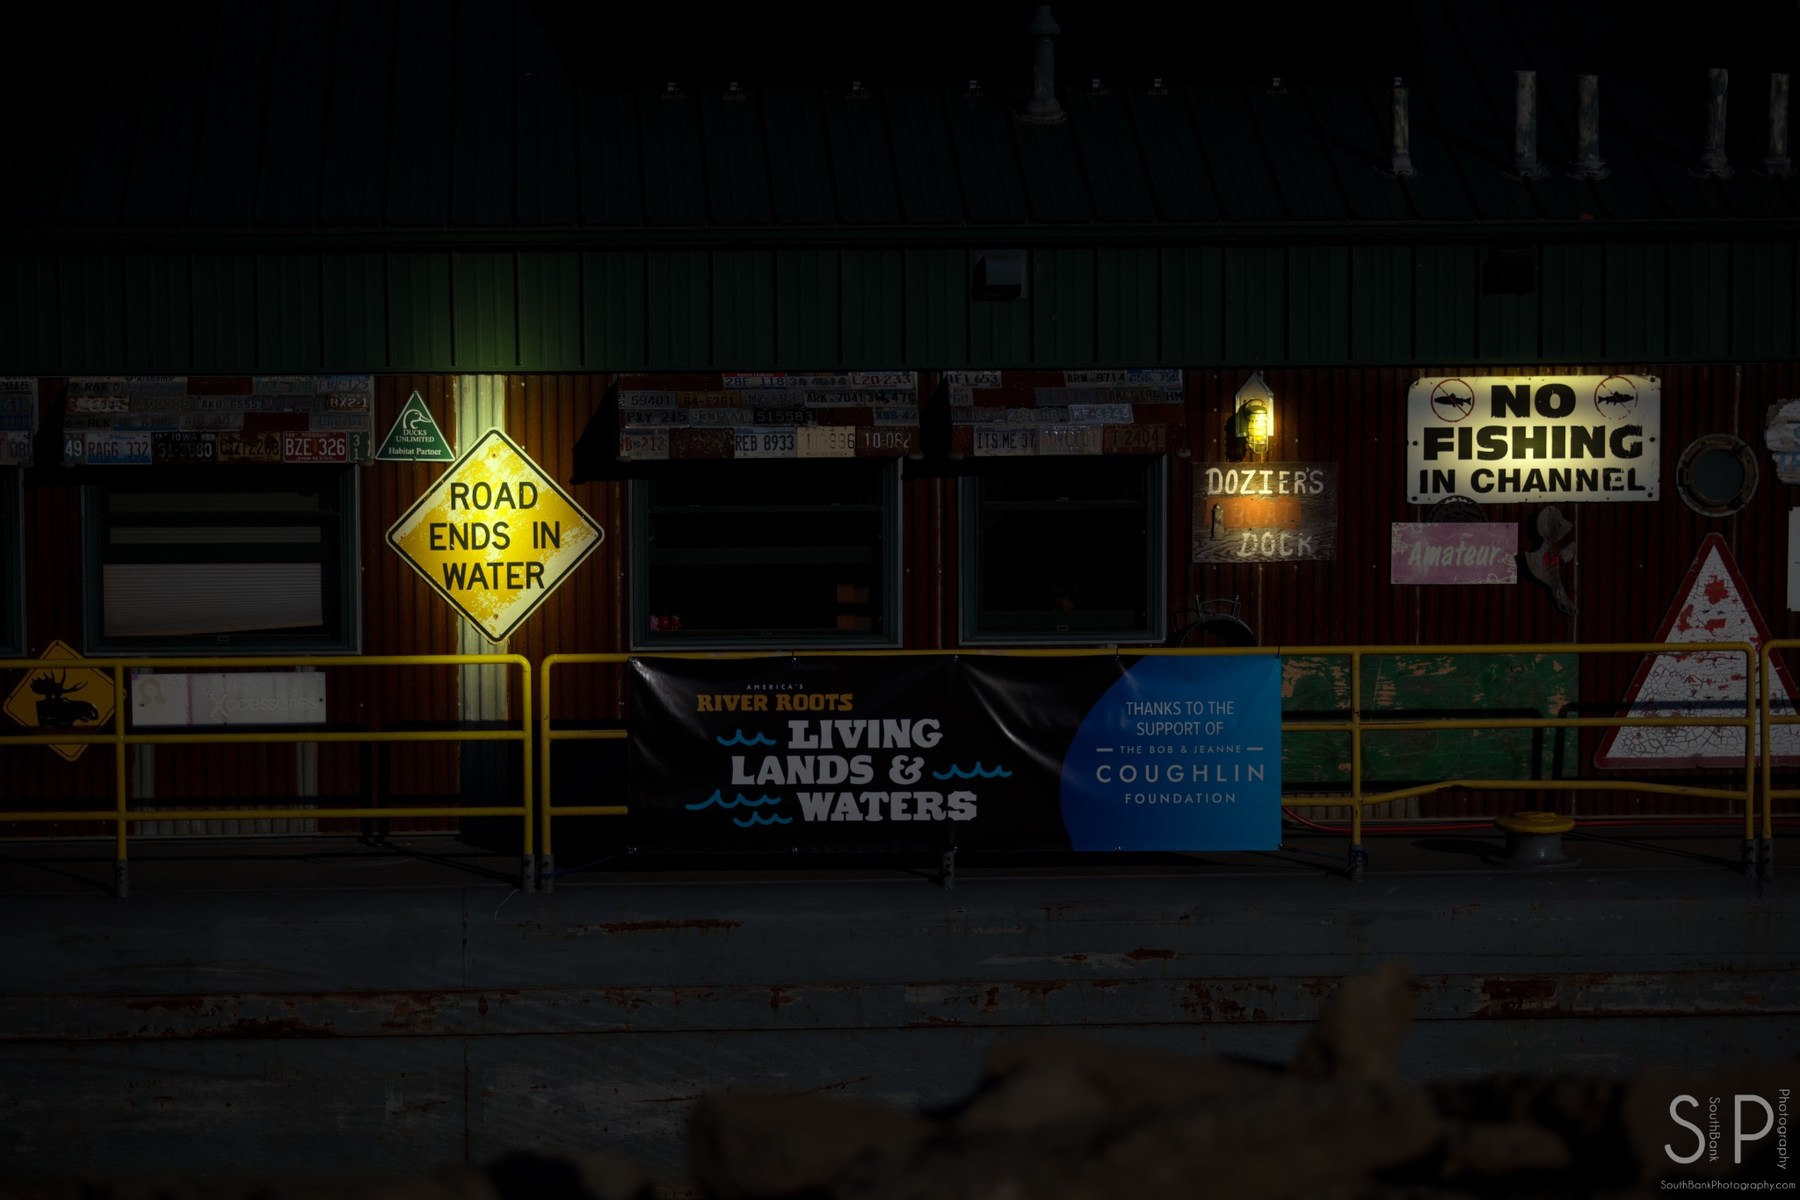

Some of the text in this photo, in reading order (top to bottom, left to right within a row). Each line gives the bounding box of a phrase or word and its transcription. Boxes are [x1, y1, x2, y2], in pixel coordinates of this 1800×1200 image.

[1491, 383, 1576, 418] NO
[285, 438, 346, 456] BZE 326
[388, 447, 442, 456] Habitat Partner
[735, 435, 757, 451] REB
[764, 435, 794, 451] 8933
[977, 433, 998, 449] ITS
[1002, 433, 1017, 449] ME
[1423, 424, 1643, 461] FISHING
[1205, 466, 1325, 495] DOZIER'S
[1420, 467, 1646, 494] IN CHANNEL
[450, 481, 538, 510] ROAD
[430, 521, 560, 551] ENDS IN
[1236, 532, 1313, 557] DOCK
[1407, 540, 1502, 567] Amateur
[442, 561, 545, 591] WATER
[746, 683, 804, 691] AMERICA'S
[696, 692, 856, 713] RIVER ROOTS
[1125, 700, 1235, 716] THANKS TO THE
[787, 718, 943, 750] LIVING
[1136, 721, 1224, 736] SUPPORT OF
[1119, 745, 1242, 754] THE BOB & JEANNE
[730, 754, 926, 786] LANDS &
[1096, 763, 1265, 784] COUGHLIN
[796, 790, 978, 822] WATERS
[1125, 792, 1236, 805] FOUNDATION
